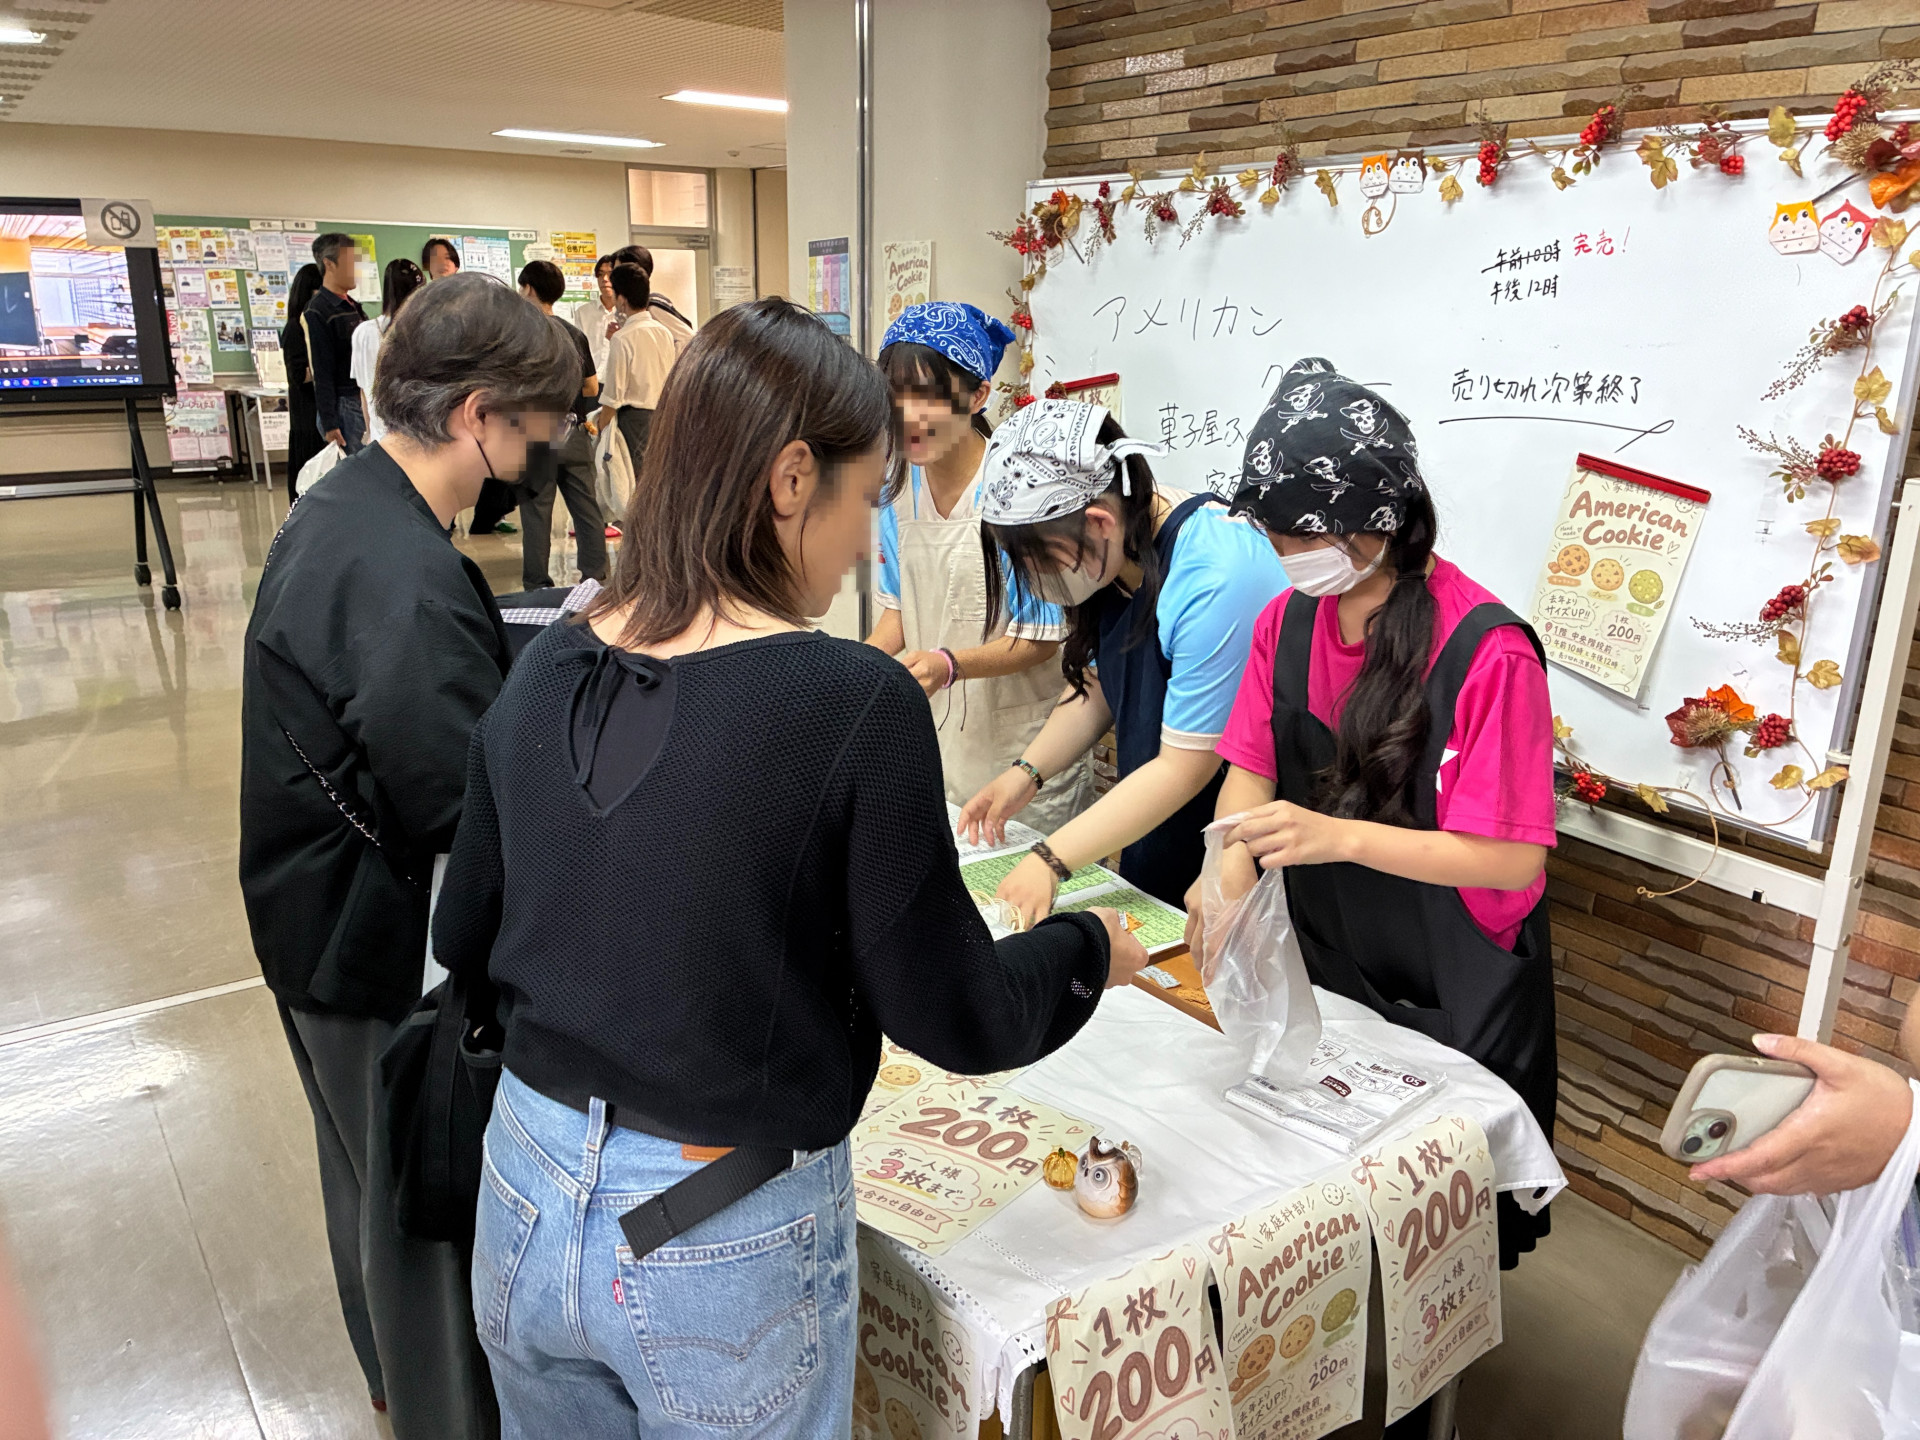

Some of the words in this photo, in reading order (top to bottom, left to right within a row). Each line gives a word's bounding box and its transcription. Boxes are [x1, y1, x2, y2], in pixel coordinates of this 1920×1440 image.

[889, 256, 929, 280] American
[896, 270, 923, 292] Cookie
[1490, 274, 1558, 303] 午後12時
[1093, 296, 1283, 341] アメリカン
[1452, 368, 1643, 404] 売り切れ次第終了
[1569, 491, 1688, 537] American
[1583, 520, 1664, 550] Cookie
[1549, 595, 1578, 606] 去年より
[1614, 614, 1629, 625] 1枚
[1553, 626, 1568, 638] 1階
[1607, 623, 1641, 643] 200円
[968, 1095, 1039, 1130] 1枚
[899, 1107, 1039, 1176] 200円
[866, 1158, 964, 1199] 3枚まで
[888, 1147, 961, 1180] お一人様
[1398, 1139, 1453, 1196] 1枚
[855, 1186, 925, 1217] み合わせ自由
[1259, 1200, 1306, 1242] 家庭科部
[1398, 1169, 1491, 1281] 200円
[1238, 1213, 1360, 1317] American
[1418, 1257, 1465, 1312] お一人様
[870, 1260, 922, 1313] 家庭科部
[1261, 1246, 1344, 1328] Cookie
[1093, 1287, 1166, 1357] 1枚
[1422, 1273, 1478, 1345] 3枚まで
[858, 1286, 971, 1412] merican
[860, 1323, 949, 1417] Cookie
[1079, 1325, 1216, 1440] 200円
[1309, 1357, 1348, 1391] 200円
